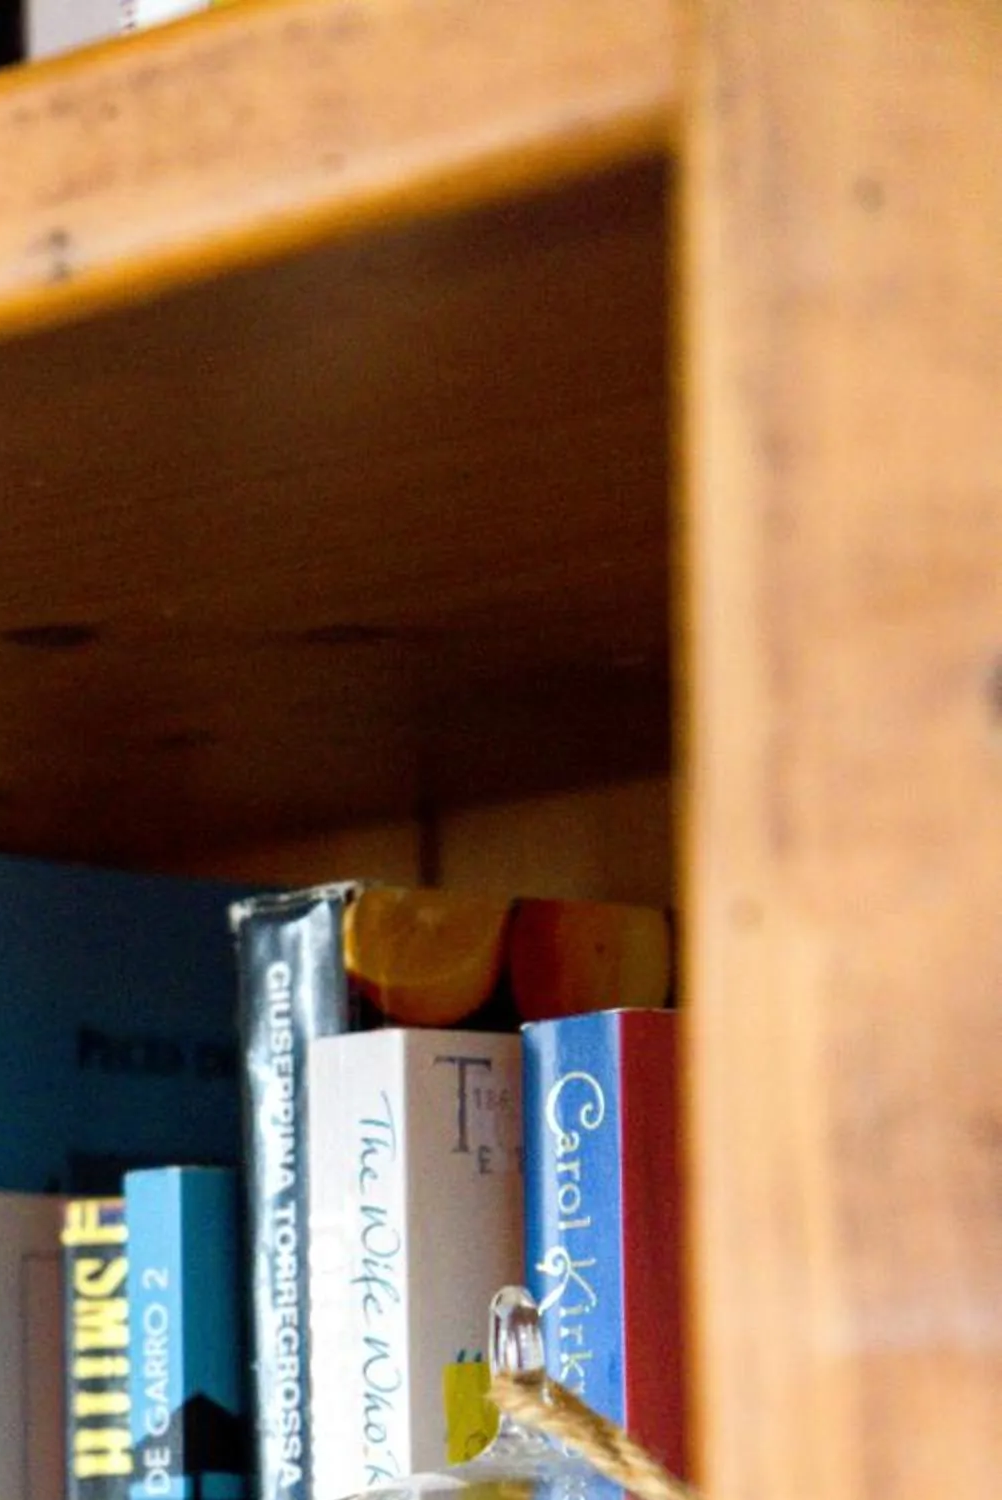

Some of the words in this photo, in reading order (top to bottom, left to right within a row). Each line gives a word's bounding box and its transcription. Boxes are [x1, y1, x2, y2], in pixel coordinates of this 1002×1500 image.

[264, 960, 295, 1194] GIUSEPPINA
[357, 1090, 399, 1194] The
[545, 1070, 605, 1232] Carol
[142, 1266, 169, 1290] 2
[350, 1205, 401, 1318] Wife
[143, 1303, 170, 1436] GARRO
[271, 1201, 303, 1487] TORREGROSSA
[362, 1324, 402, 1444] Who
[144, 1445, 171, 1496] DE
